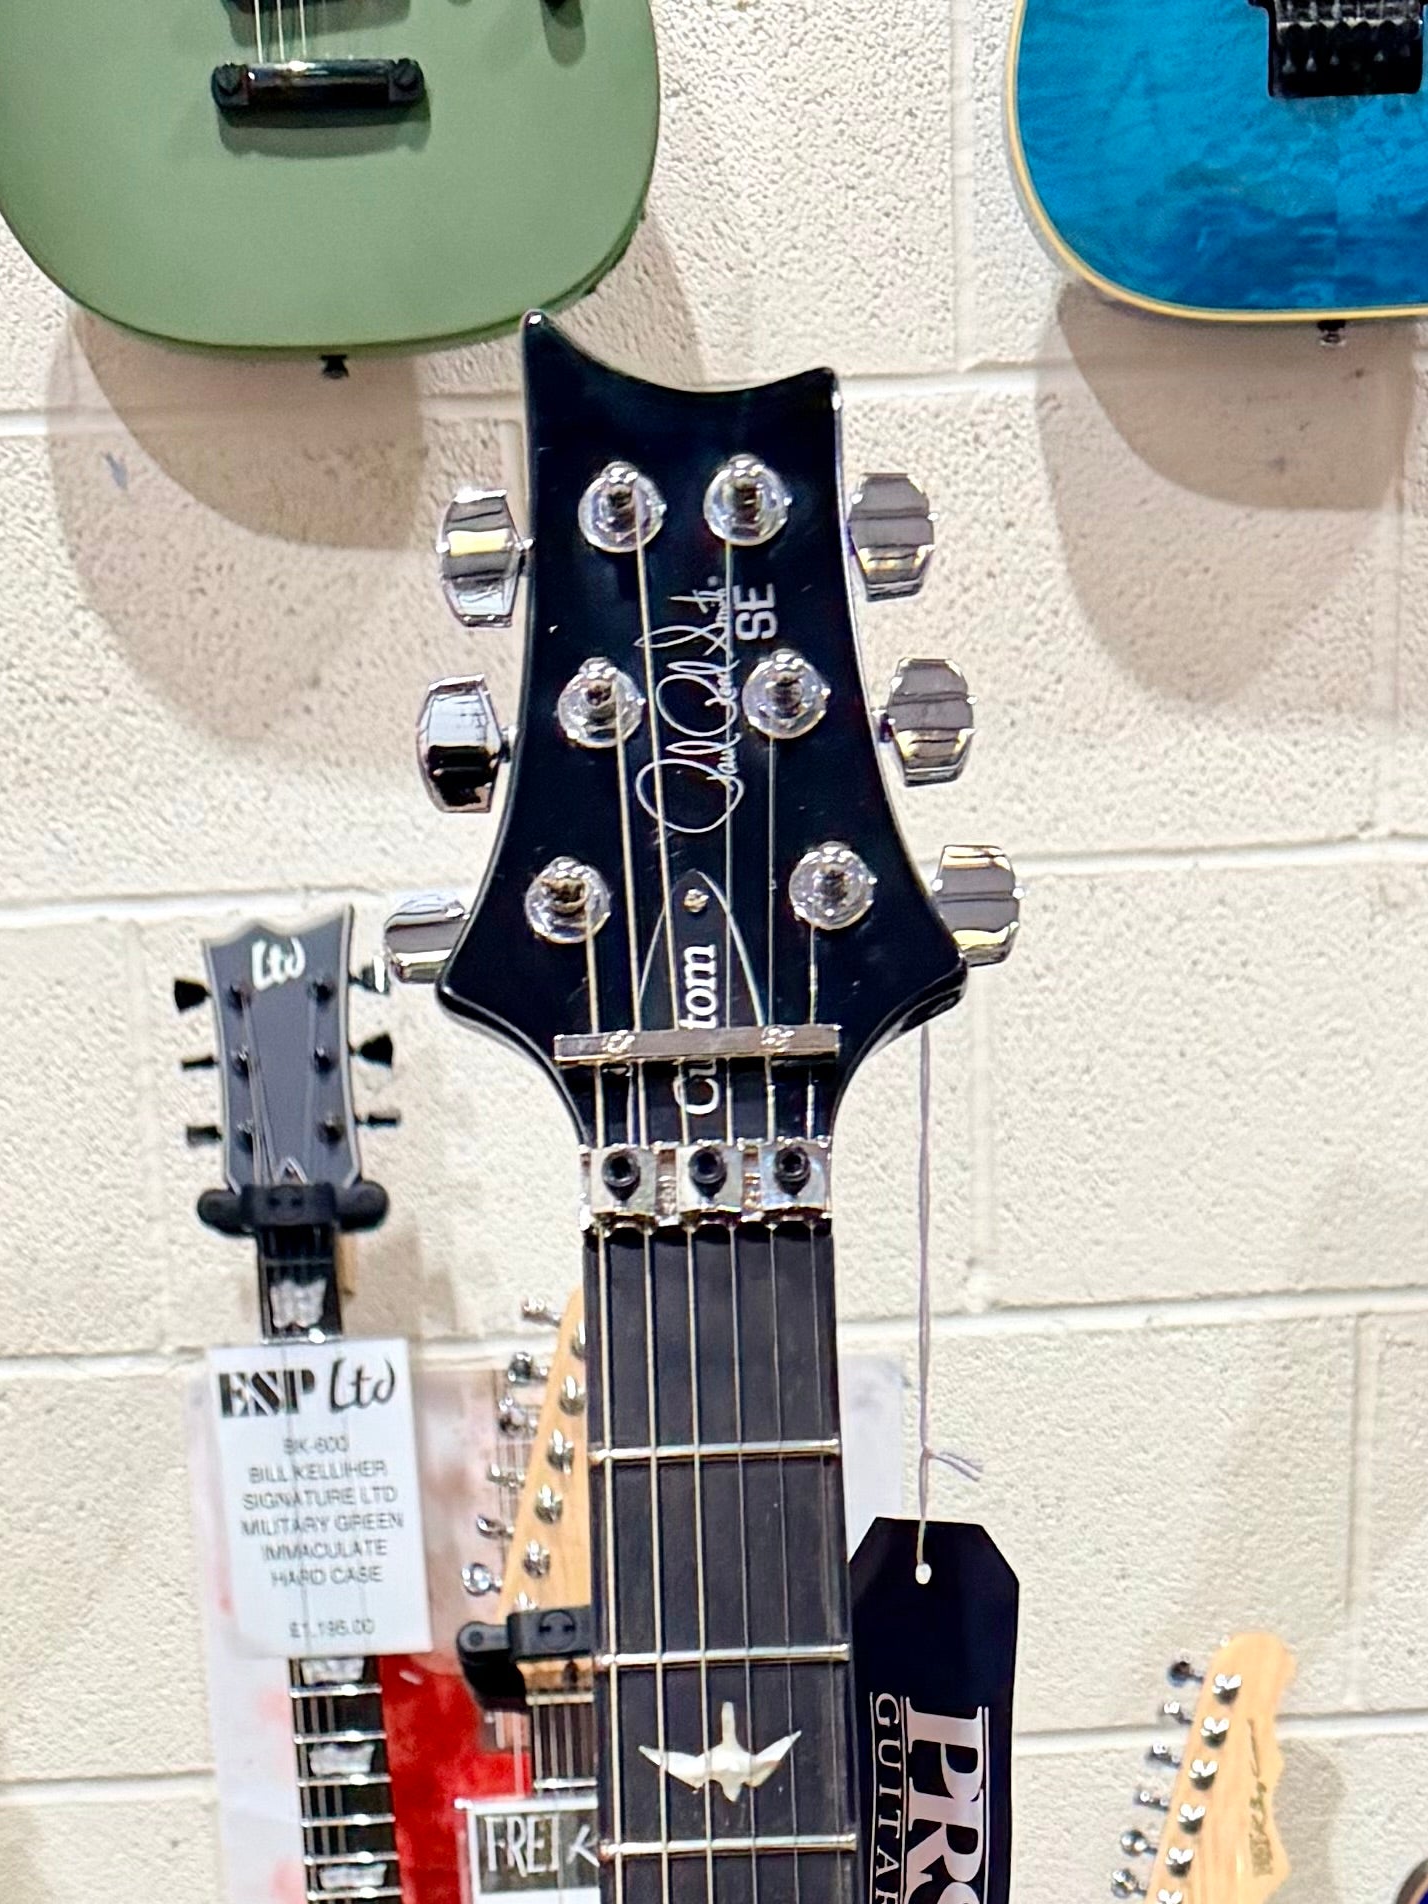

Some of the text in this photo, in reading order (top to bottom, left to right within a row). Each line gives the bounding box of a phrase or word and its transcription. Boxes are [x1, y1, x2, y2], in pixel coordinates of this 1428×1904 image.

[732, 583, 778, 641] SE
[219, 1368, 316, 1419] ESP
[248, 1466, 289, 1485] BILL
[243, 1484, 399, 1511] SIGNATURE LTD
[240, 1511, 405, 1536] MILITARY GREEN
[261, 1540, 388, 1562] IMMACULATE
[270, 1565, 384, 1587] HARD CASE
[484, 1813, 562, 1878] FRET
